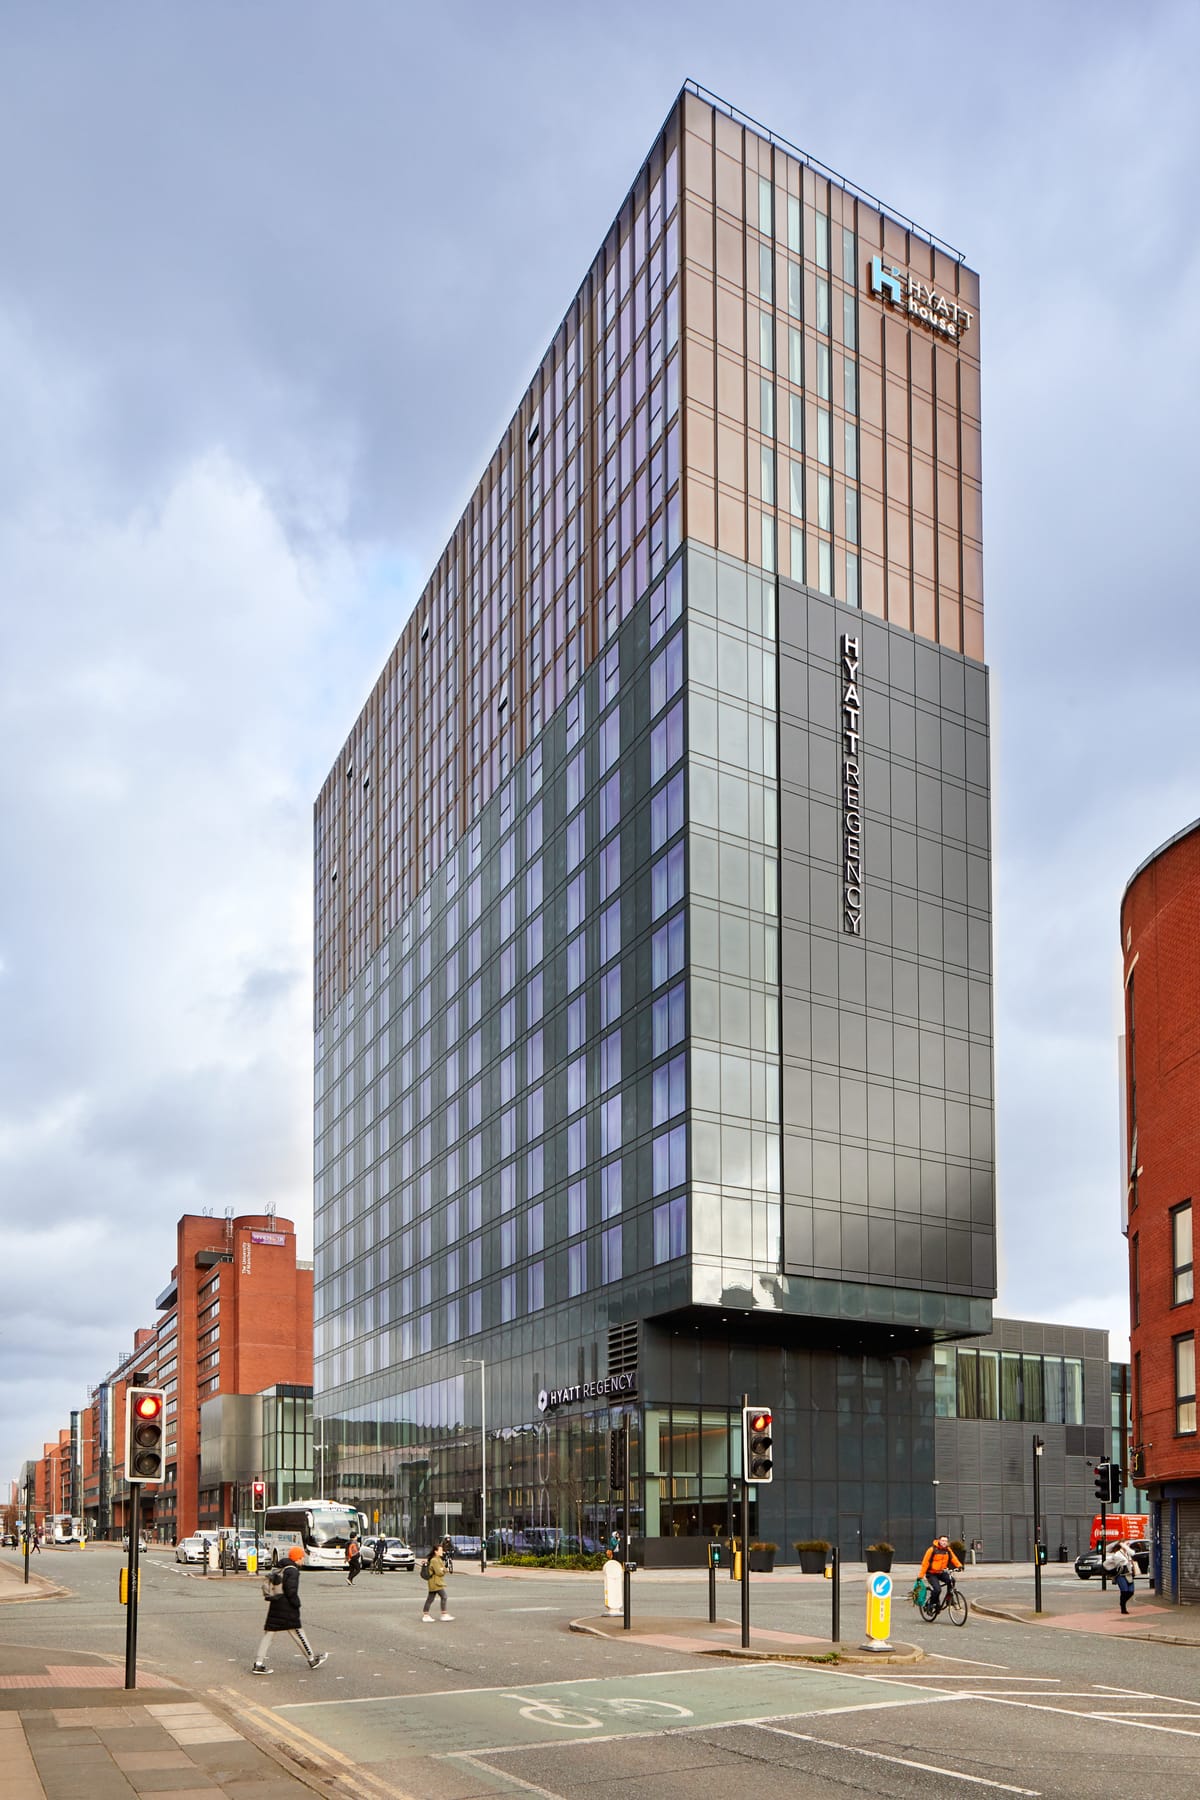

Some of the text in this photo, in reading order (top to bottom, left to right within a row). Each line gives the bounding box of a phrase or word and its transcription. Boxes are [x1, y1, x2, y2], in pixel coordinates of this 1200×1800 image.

[908, 276, 974, 329] HYATT
[908, 296, 956, 335] house
[844, 633, 862, 933] HYATT REGENCY
[550, 1373, 633, 1405] HYATT REGENCY
